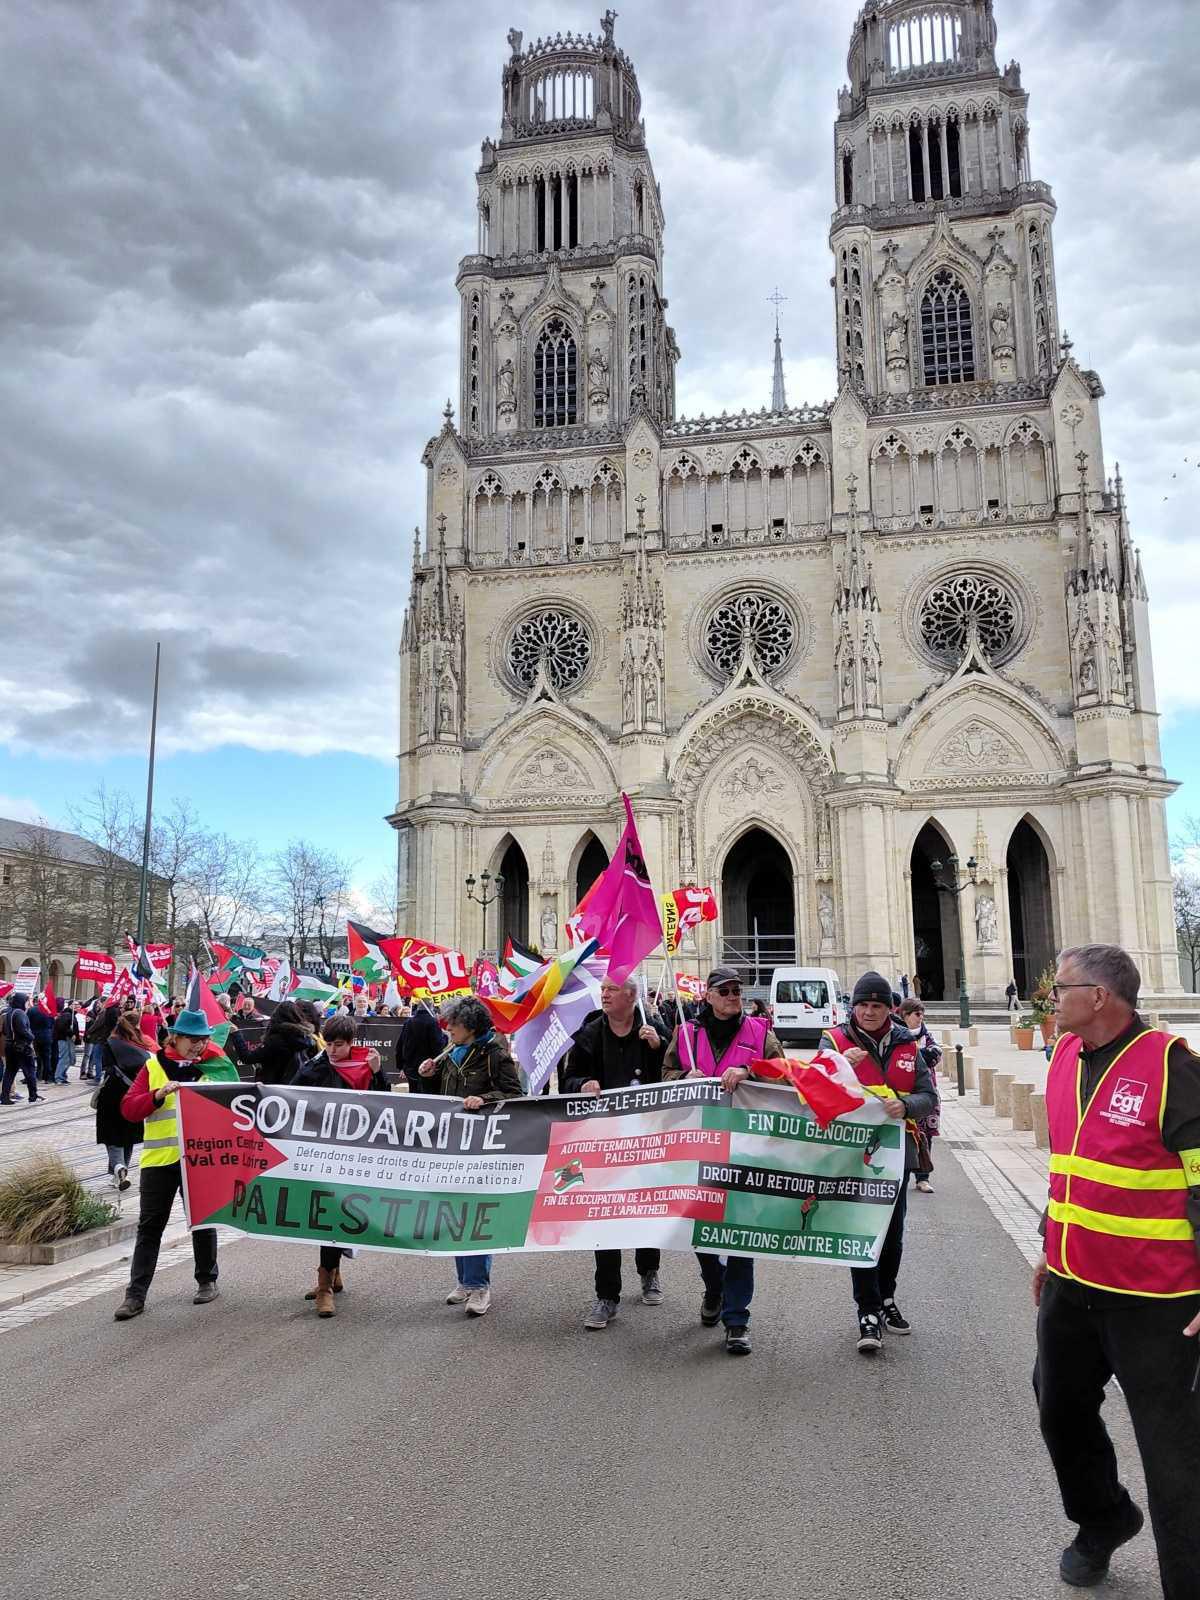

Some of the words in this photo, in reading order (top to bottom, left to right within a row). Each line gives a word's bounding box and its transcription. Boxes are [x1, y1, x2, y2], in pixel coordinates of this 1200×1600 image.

[400, 939, 441, 960] la
[401, 951, 466, 992] cgt
[362, 1038, 382, 1048] juste
[383, 1039, 392, 1047] et
[566, 1090, 658, 1116] CESSEZ-LE-FEU
[661, 1084, 725, 1104] DÉFINITIF
[1112, 1093, 1143, 1113] cgt
[230, 1094, 510, 1150] SOLIDARITÉ
[748, 1113, 774, 1131] FIN
[779, 1117, 801, 1135] DU
[186, 1137, 232, 1152] Région
[664, 1134, 677, 1146] DU
[679, 1132, 721, 1145] PEUPLE
[187, 1153, 215, 1168] Val
[220, 1153, 239, 1165] de
[296, 1146, 354, 1162] Défendons
[357, 1153, 374, 1164] les
[377, 1155, 408, 1168] droits
[411, 1158, 426, 1169] du
[429, 1160, 465, 1172] peuple
[466, 1160, 525, 1172] palestinien
[605, 1147, 666, 1164] PALESTINIEN
[293, 1163, 314, 1173] sur
[320, 1162, 332, 1174] la
[339, 1165, 371, 1178] base
[377, 1169, 393, 1180] du
[400, 1171, 430, 1183] droit
[436, 1174, 523, 1185] international
[702, 1166, 742, 1183] DROIT
[745, 1171, 764, 1187] AU
[767, 1175, 815, 1194] RETOUR
[818, 1180, 836, 1195] DES
[838, 1178, 896, 1199] RÉFUGIÉS
[543, 1195, 556, 1206] FIN
[558, 1194, 568, 1206] DE
[570, 1193, 625, 1206] L'OCCUPATION
[628, 1192, 639, 1204] DE
[639, 1191, 651, 1202] LA
[654, 1188, 724, 1204] COLONNISATION
[232, 1180, 500, 1243] PALESTINE
[588, 1206, 600, 1217] ET
[601, 1206, 612, 1217] DE
[613, 1204, 668, 1215] L'APARTHEID
[700, 1226, 780, 1250] SANCTIONS
[783, 1235, 833, 1254] CONTRE
[838, 1238, 873, 1257] ISRA
